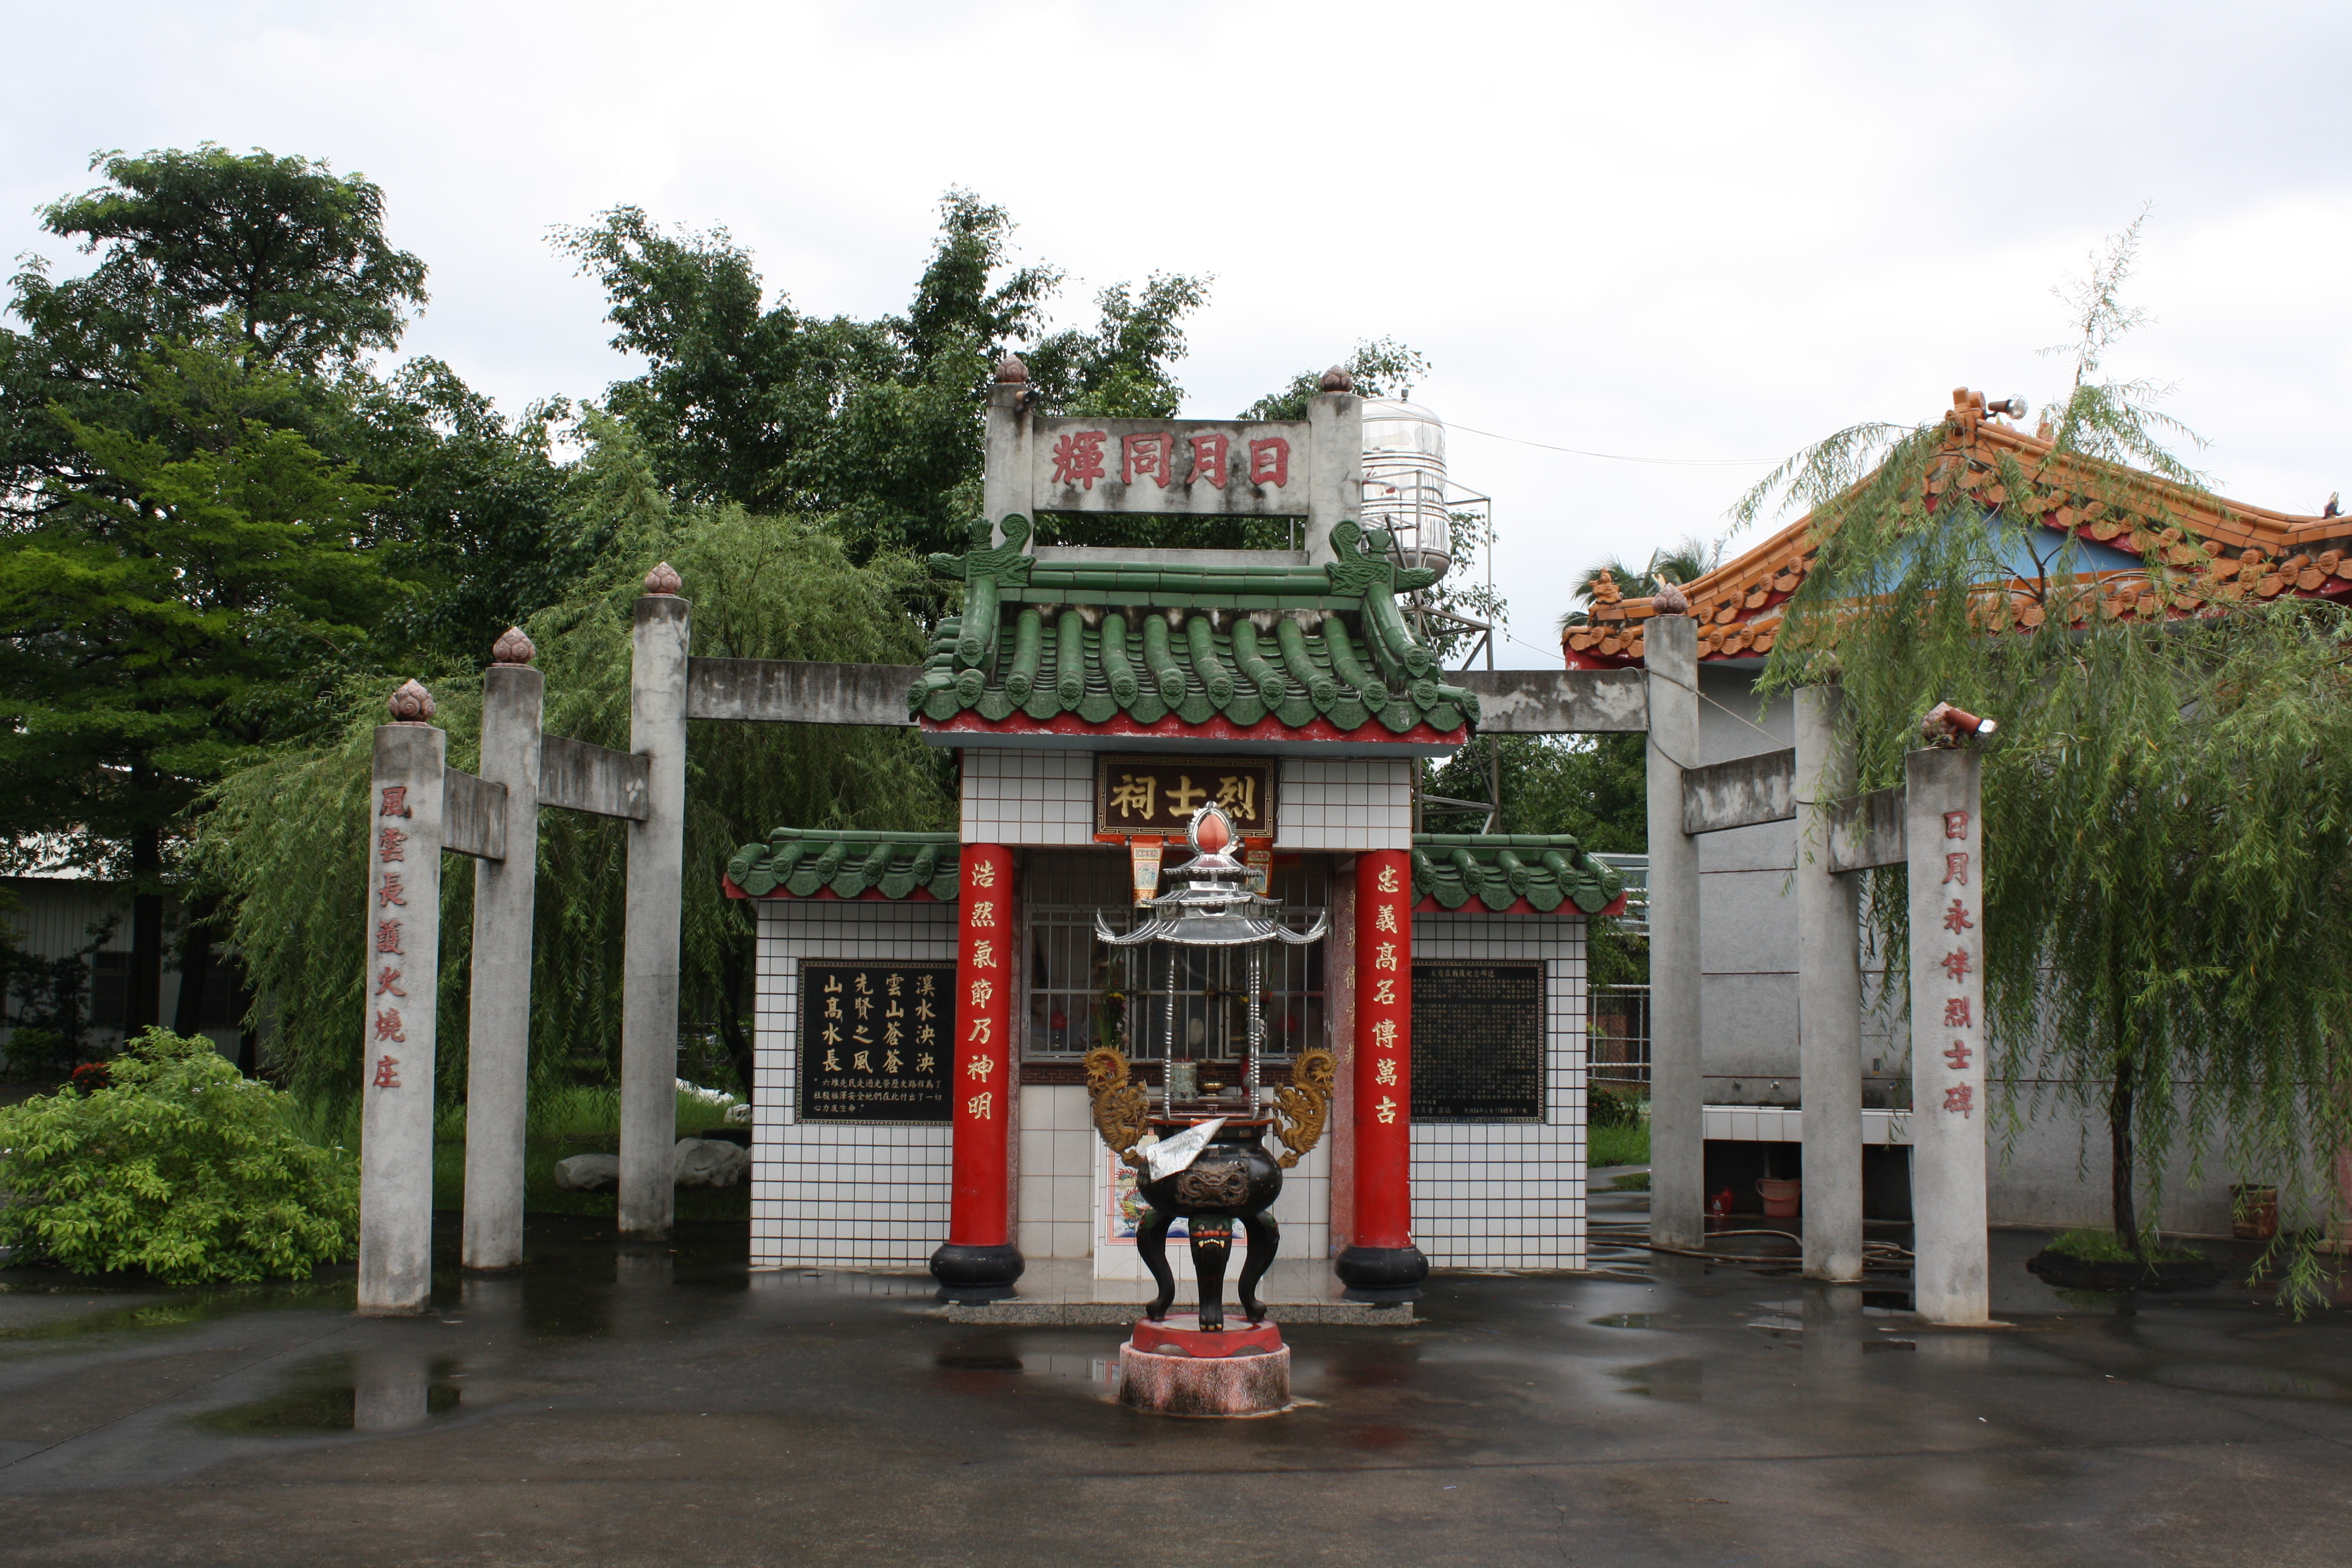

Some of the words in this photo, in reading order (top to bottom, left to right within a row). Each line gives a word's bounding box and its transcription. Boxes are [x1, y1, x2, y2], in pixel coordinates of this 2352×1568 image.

[1052, 430, 1290, 490] 日月同輝
[1110, 774, 1256, 821] 烈士祠
[372, 786, 413, 1088] 風雲長護火燒庄
[1942, 810, 1974, 1120] 日月永伴烈士碑
[822, 975, 843, 1072] 山高水長
[852, 972, 875, 1074] 先賢之風
[882, 973, 905, 1074] 雲山蒼蒼
[915, 974, 936, 1074] 溪水泱泱
[967, 860, 997, 1120] 浩然氣節乃神明
